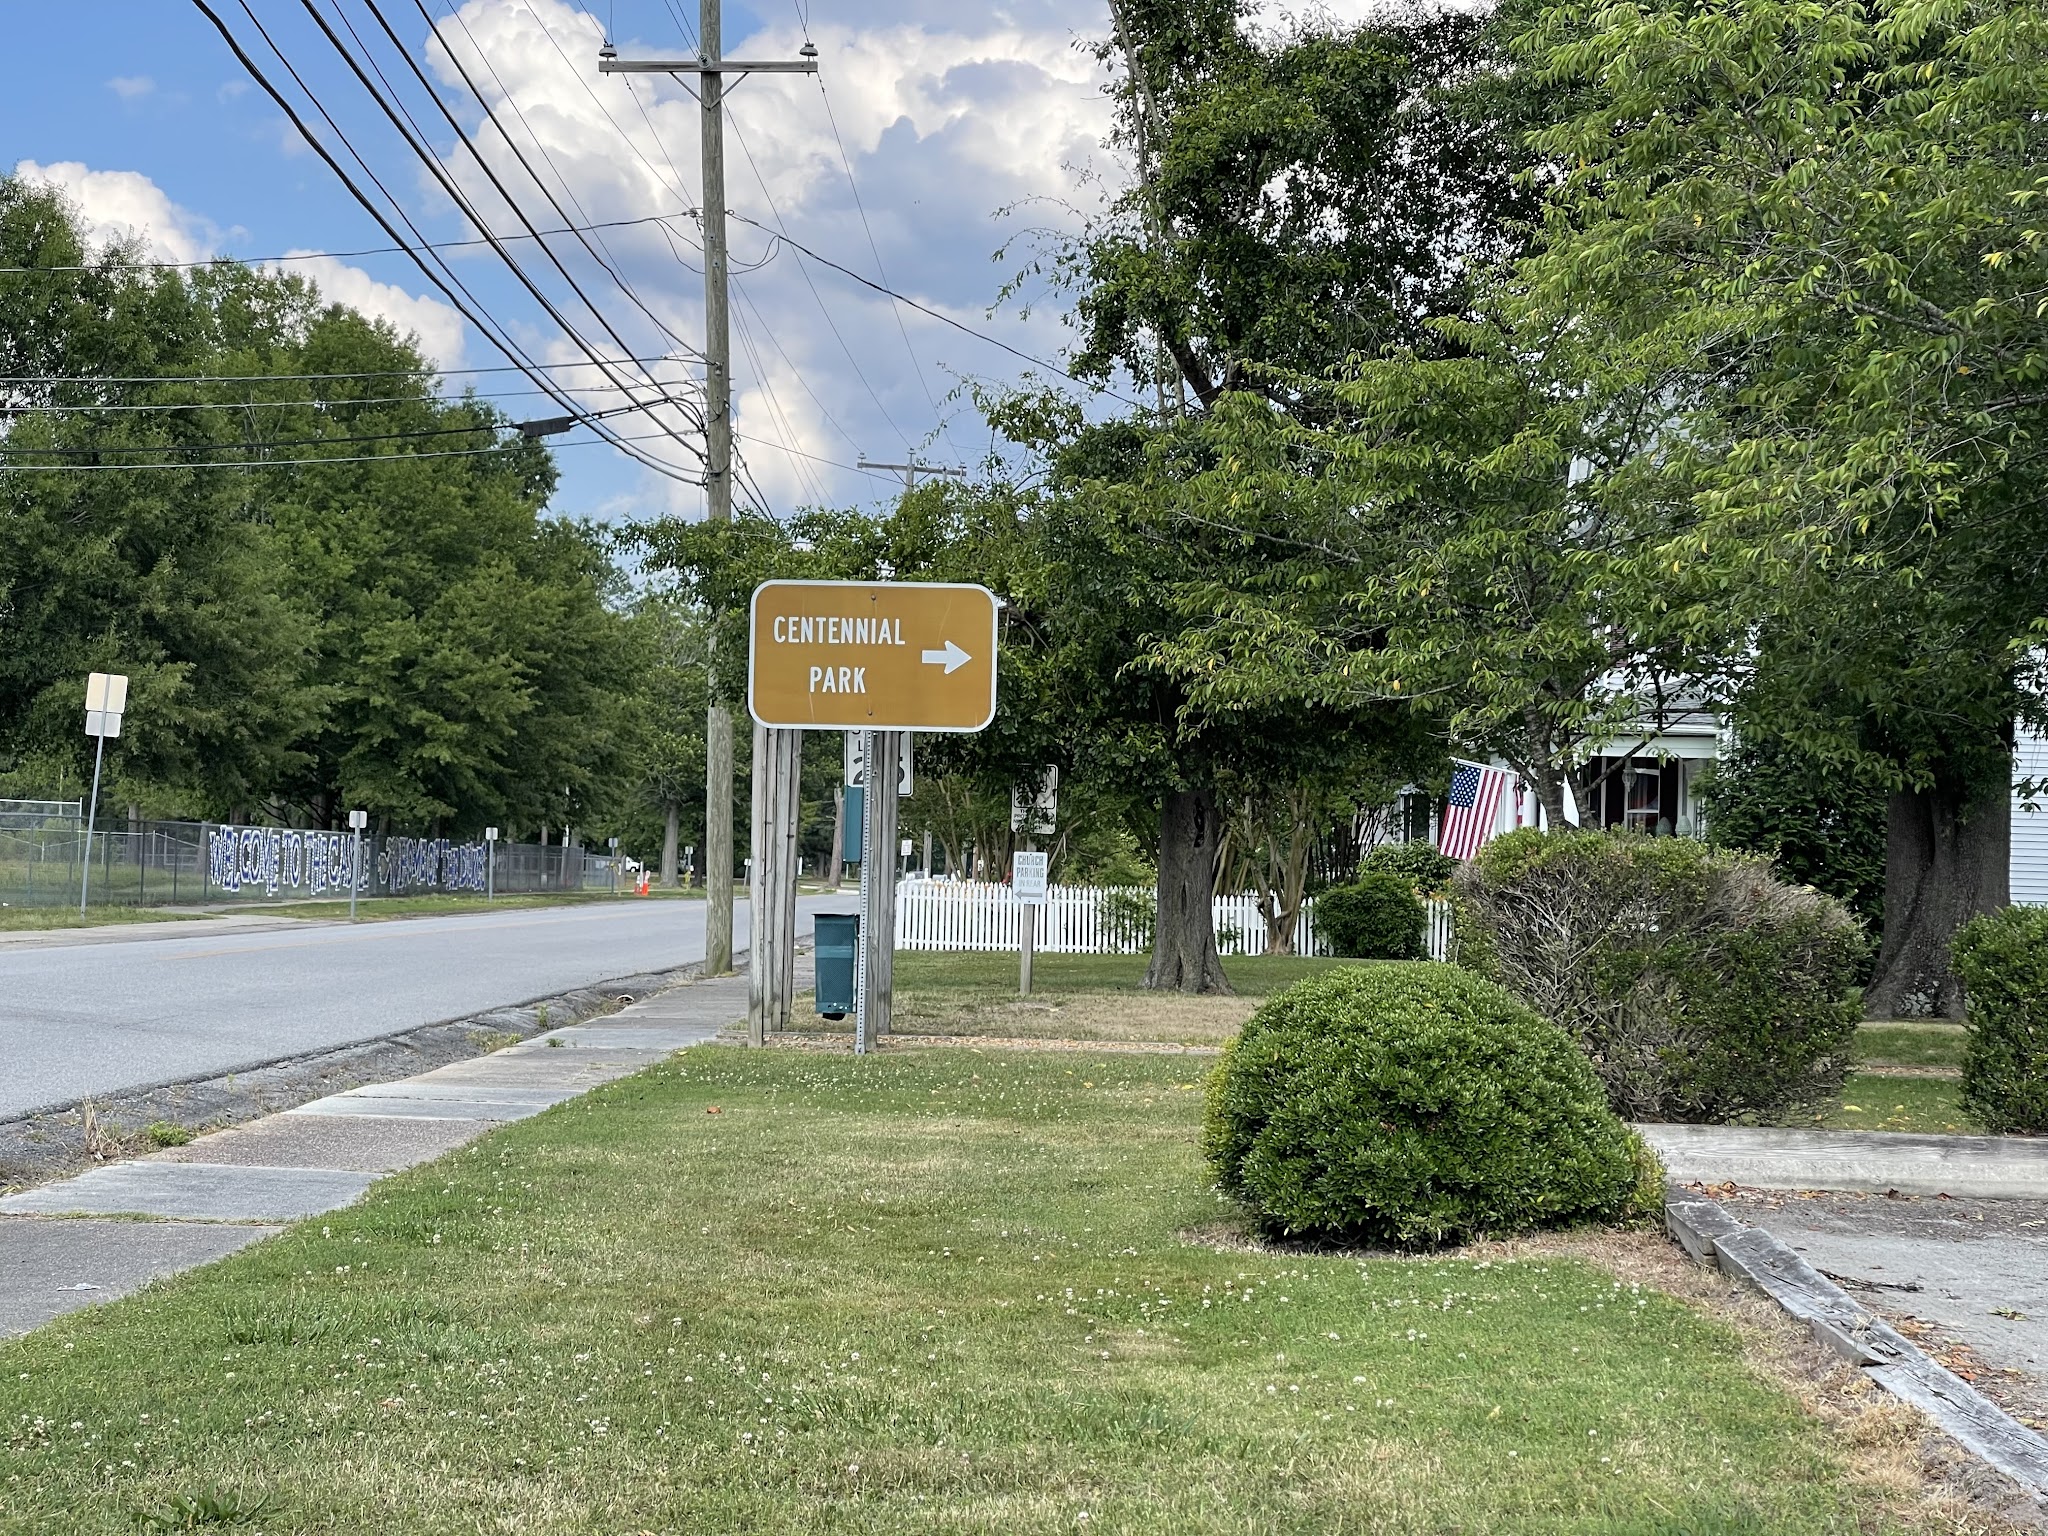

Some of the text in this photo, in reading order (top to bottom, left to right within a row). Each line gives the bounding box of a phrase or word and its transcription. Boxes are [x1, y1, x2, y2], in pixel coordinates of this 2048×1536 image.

[773, 616, 906, 645] CENTENNIAL
[809, 666, 866, 693] PARK
[209, 825, 280, 896] WELCOME
[282, 830, 301, 888] TO
[305, 831, 327, 895] THE
[1016, 867, 1044, 878] PARKING
[1017, 855, 1044, 866] CHURCH
